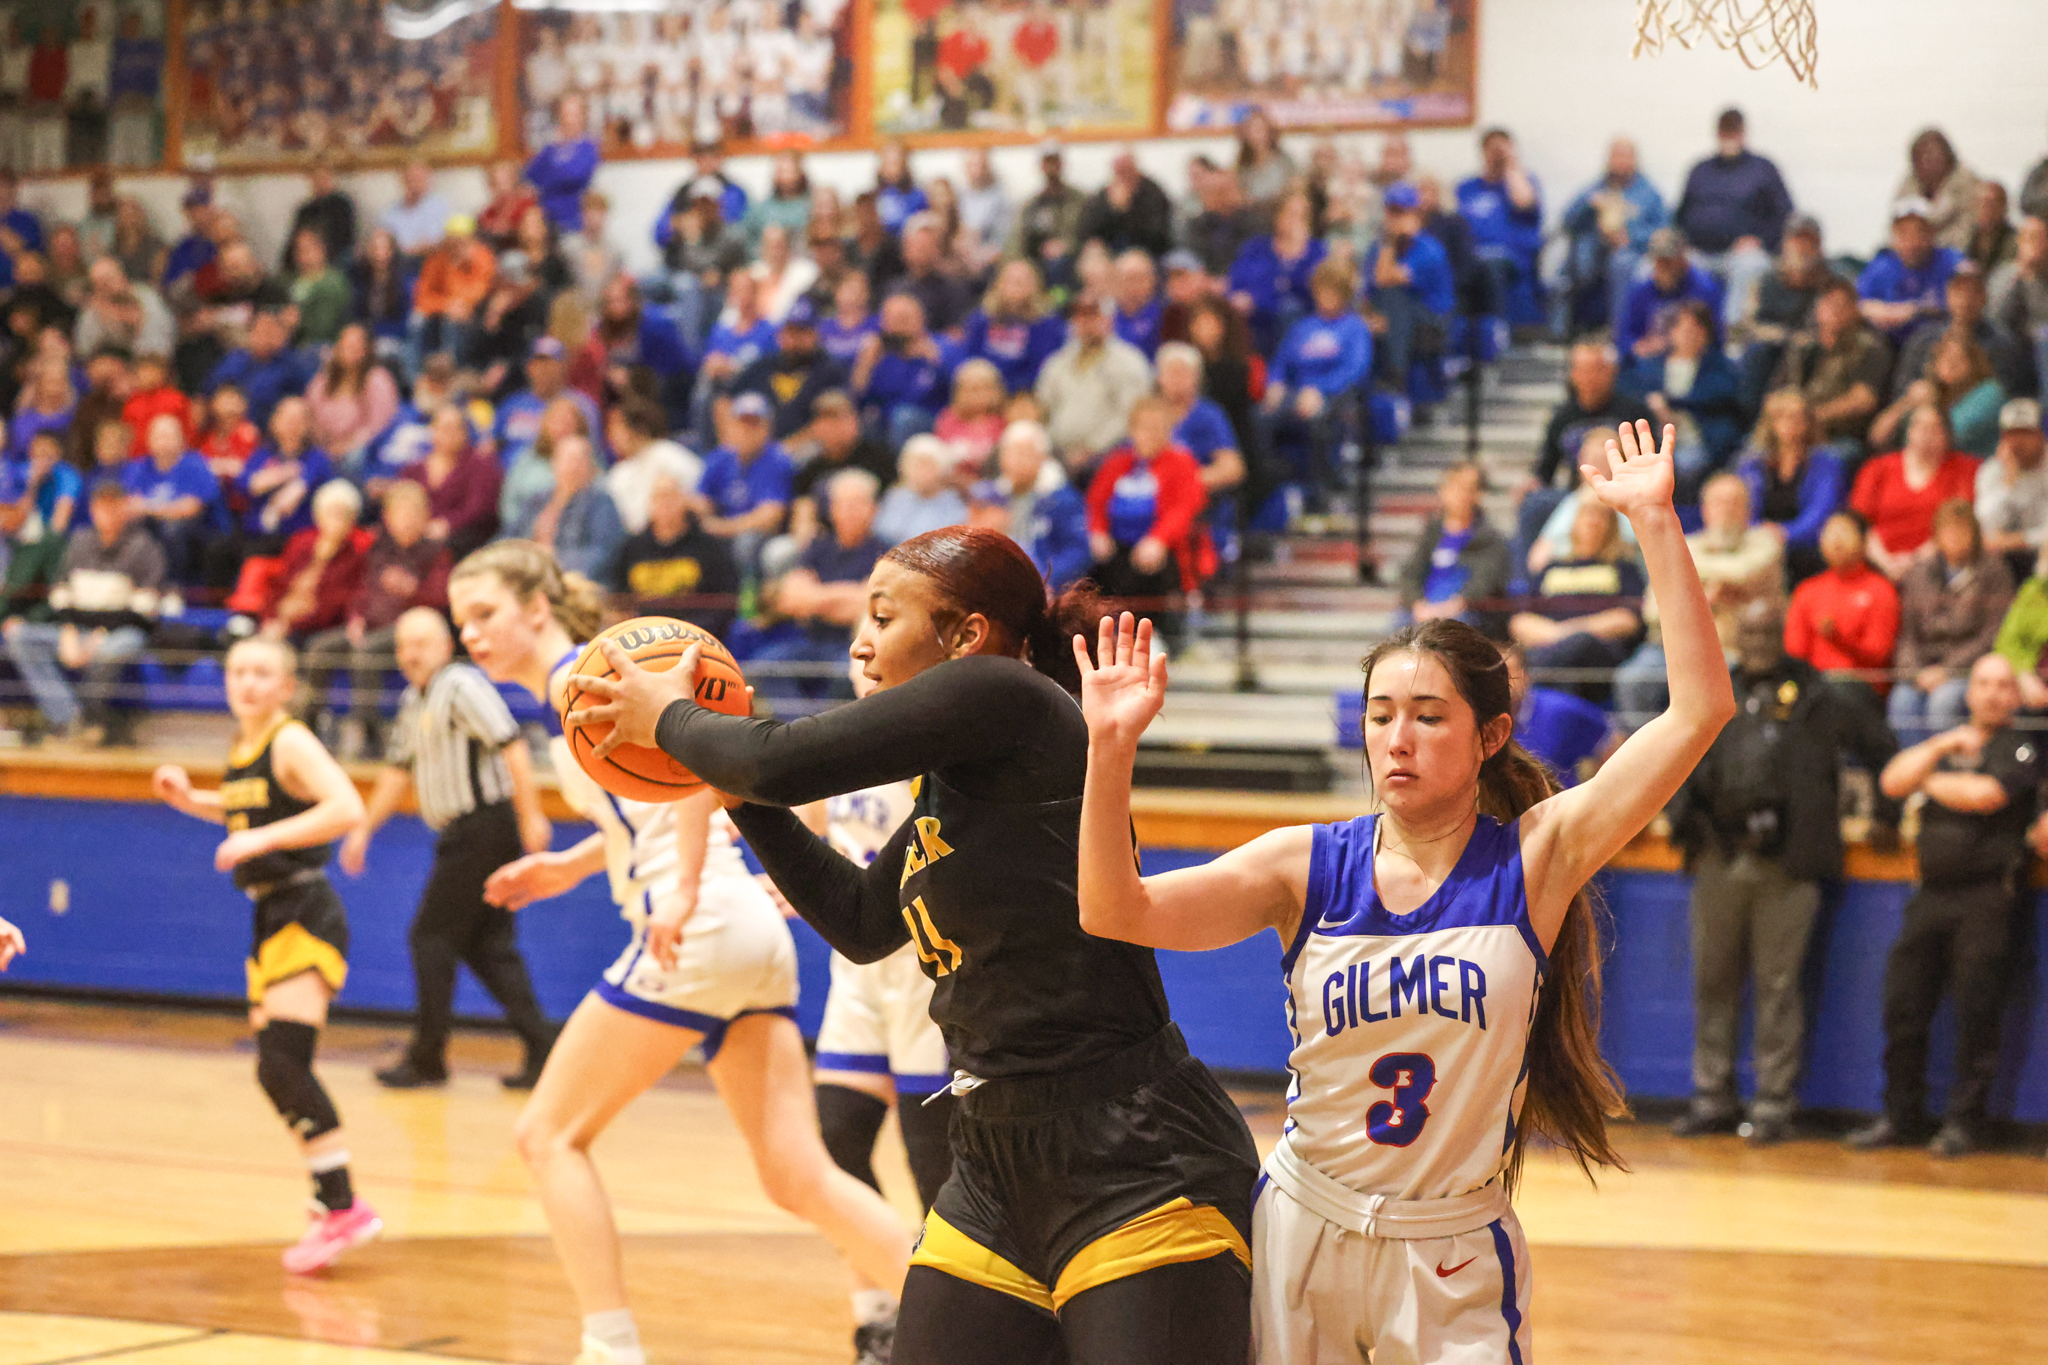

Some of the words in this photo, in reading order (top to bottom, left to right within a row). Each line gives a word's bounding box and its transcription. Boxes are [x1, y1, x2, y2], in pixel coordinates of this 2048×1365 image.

[902, 895, 963, 978] 11
[1322, 953, 1487, 1037] GILMER
[1365, 1051, 1438, 1148] 3
